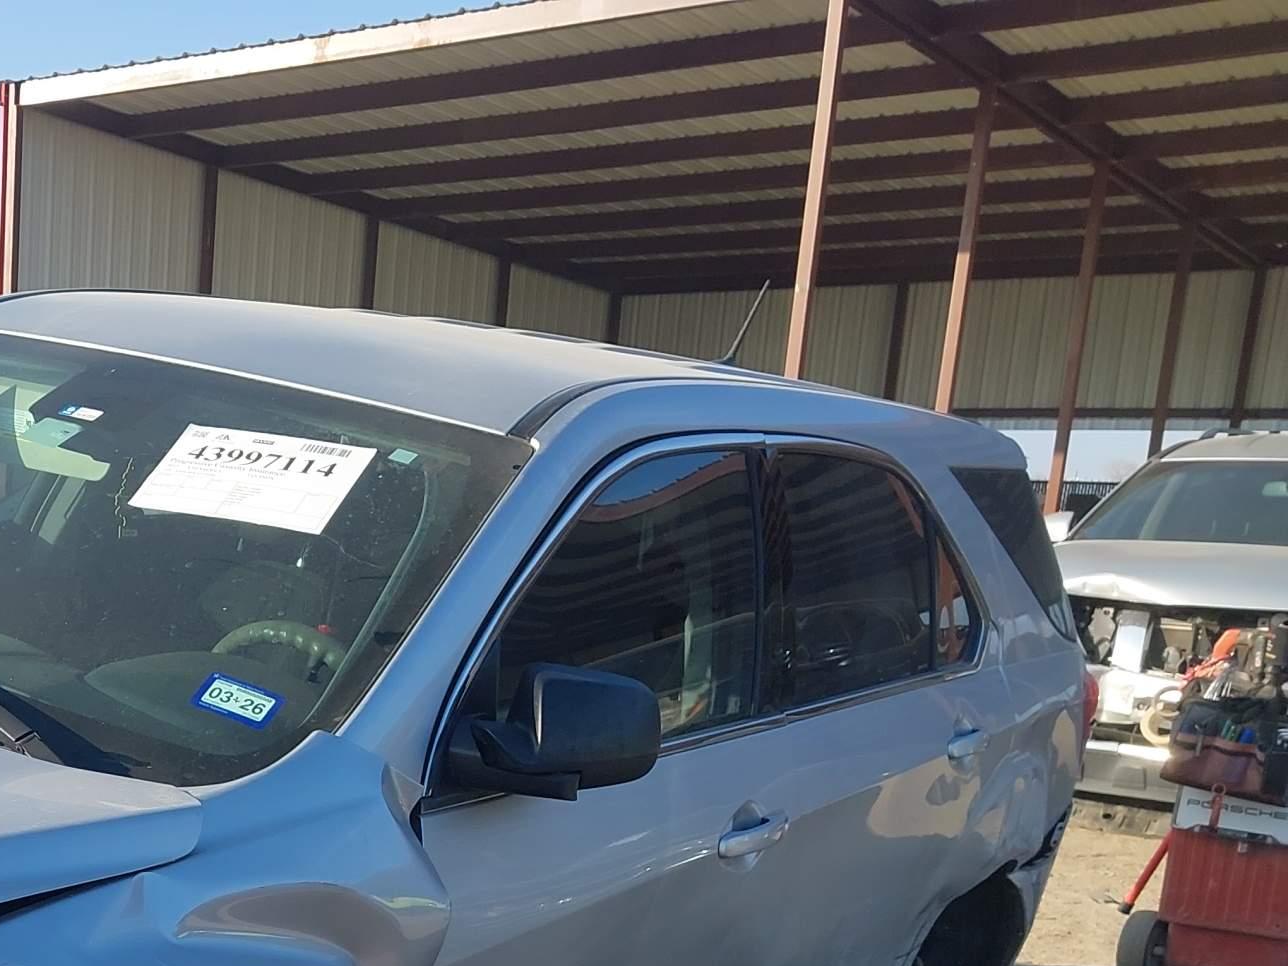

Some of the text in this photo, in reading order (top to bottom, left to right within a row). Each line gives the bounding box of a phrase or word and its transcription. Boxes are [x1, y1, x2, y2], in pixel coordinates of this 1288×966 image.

[187, 444, 338, 478] 43997114
[208, 687, 234, 703] 03
[239, 698, 267, 715] 26
